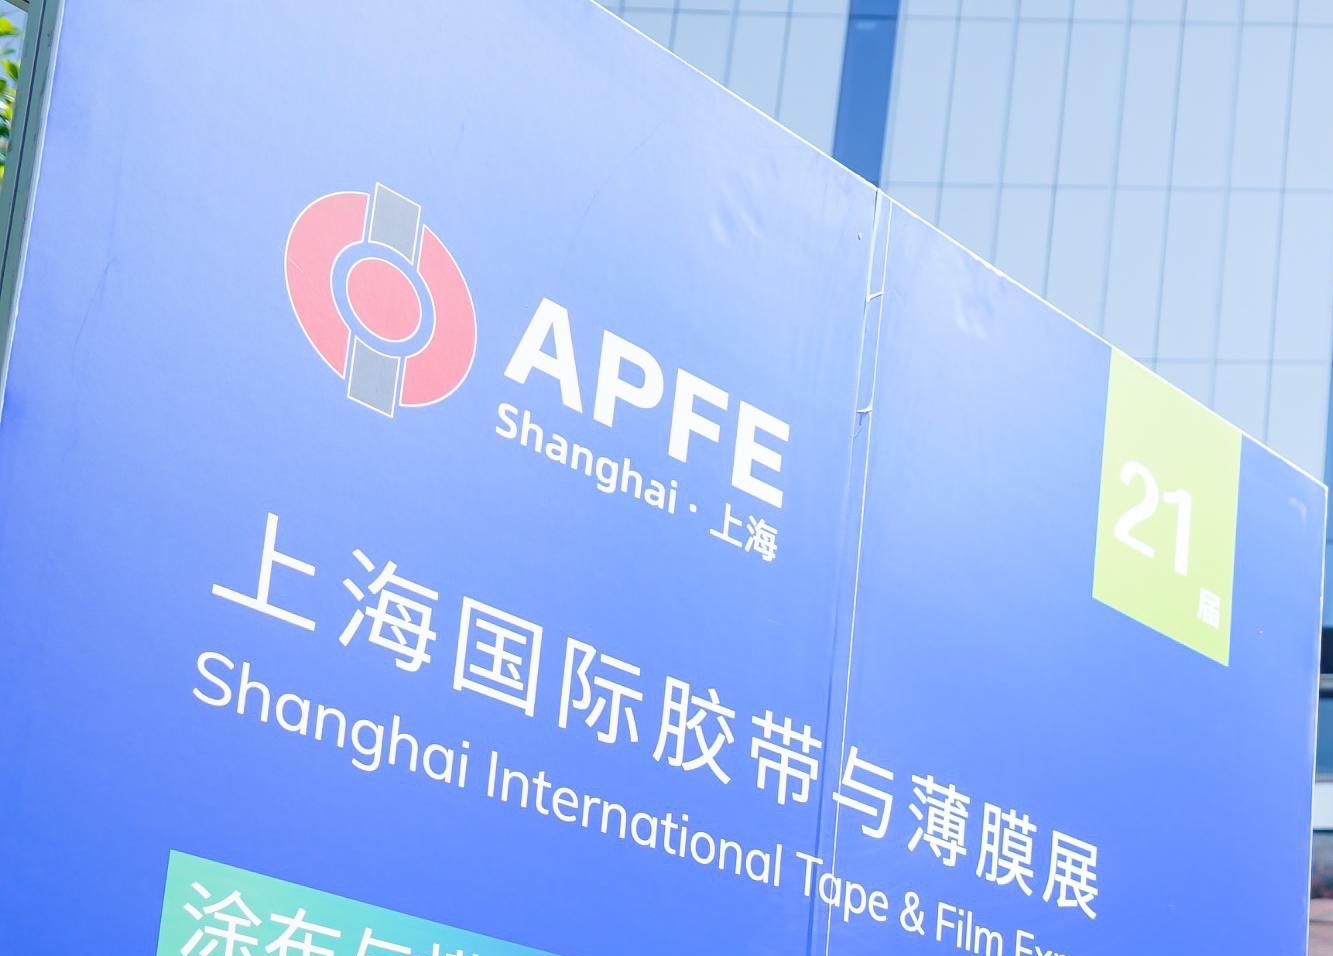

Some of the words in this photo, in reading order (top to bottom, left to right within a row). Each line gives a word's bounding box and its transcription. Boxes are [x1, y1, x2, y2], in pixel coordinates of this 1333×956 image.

[496, 402, 678, 515] Shanghai
[710, 503, 778, 562] 上海
[503, 297, 790, 509] APFE
[1115, 461, 1192, 577] 21
[192, 651, 470, 773] Shanghai
[487, 751, 783, 887] International
[796, 851, 889, 922] Tape
[900, 891, 926, 936] &
[212, 513, 1099, 920] 上海国际胶带与薄膜展
